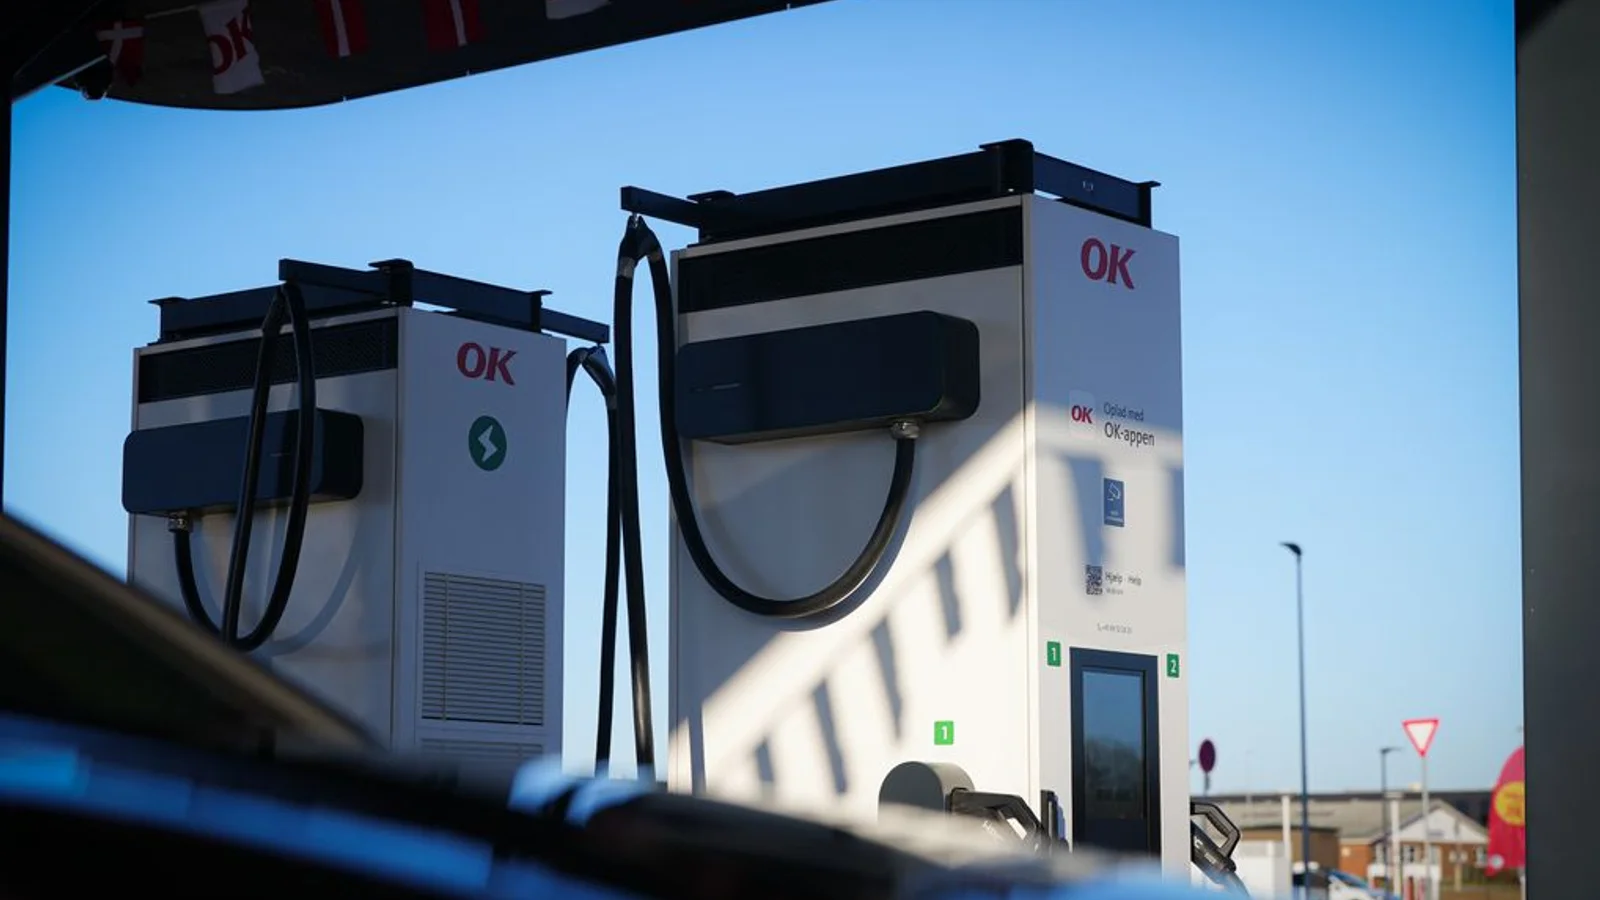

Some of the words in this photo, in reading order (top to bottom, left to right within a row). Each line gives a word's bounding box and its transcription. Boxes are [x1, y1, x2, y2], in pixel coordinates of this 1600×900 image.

[206, 9, 254, 76] OK
[1081, 237, 1136, 290] OK
[457, 342, 517, 386] OK
[1071, 405, 1093, 424] OK
[1103, 402, 1127, 418] Oplad
[1128, 408, 1144, 422] med
[1104, 421, 1155, 447] OK-appen
[1169, 658, 1177, 674] 2
